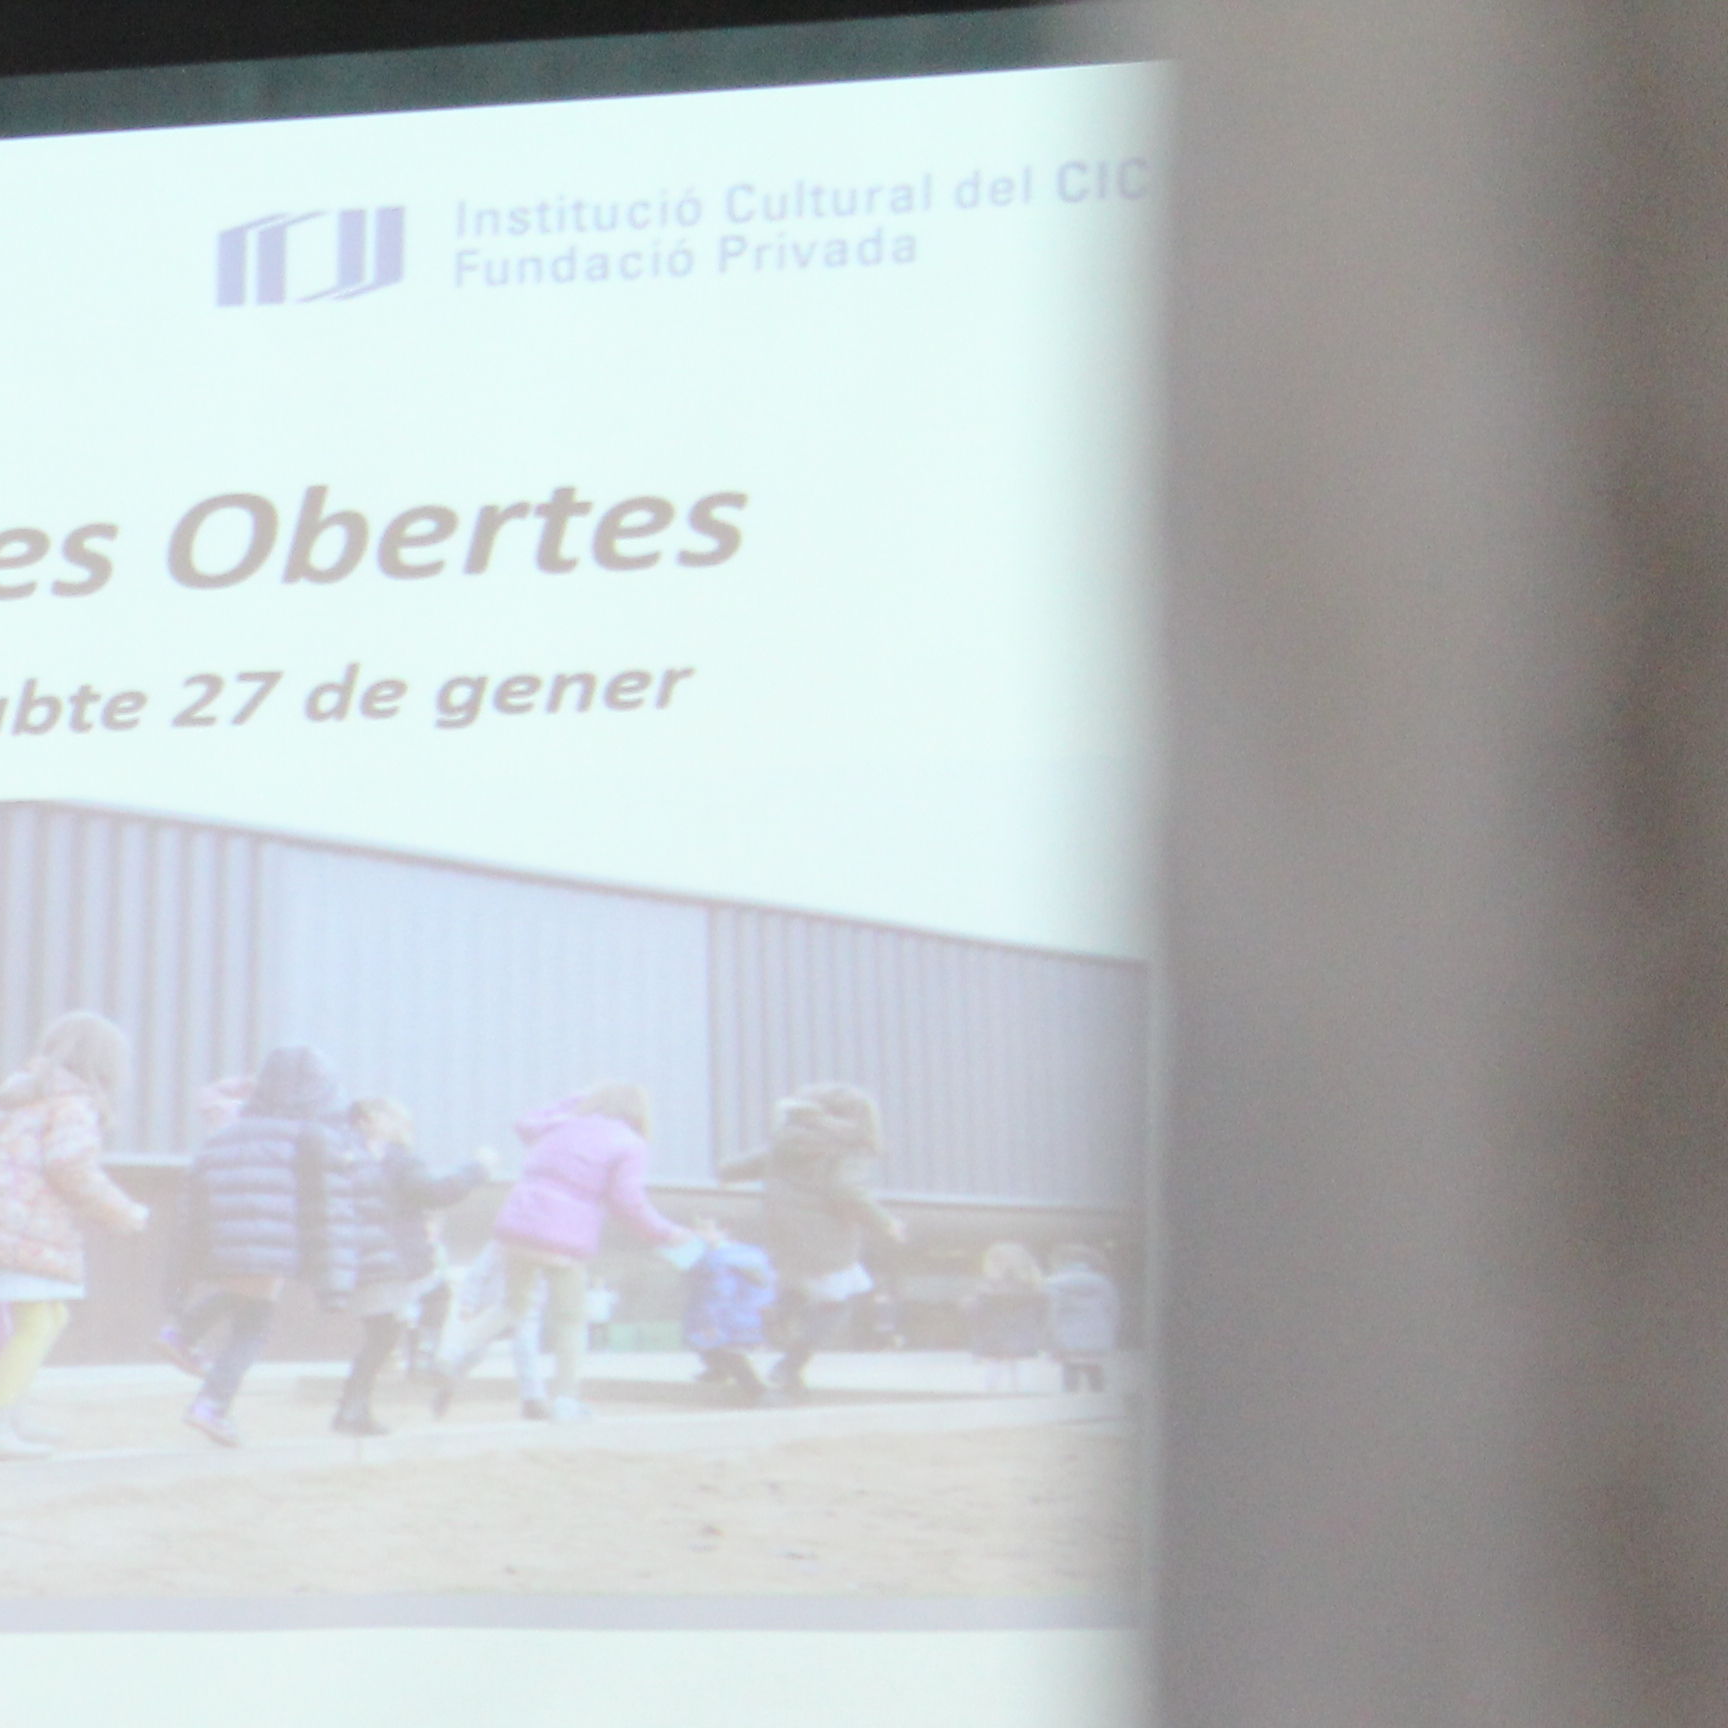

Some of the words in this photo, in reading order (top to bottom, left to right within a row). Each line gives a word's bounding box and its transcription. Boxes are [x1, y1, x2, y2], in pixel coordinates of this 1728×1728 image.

[454, 187, 703, 239] Institució
[725, 174, 931, 226] Cultural
[953, 165, 1032, 212] del
[1055, 156, 1153, 204] CIC
[453, 236, 695, 290] Fundació
[717, 229, 920, 275] Privada
[165, 482, 748, 591] Obertes
[170, 668, 284, 730] 27
[301, 660, 408, 724] de
[433, 662, 695, 732] gener
